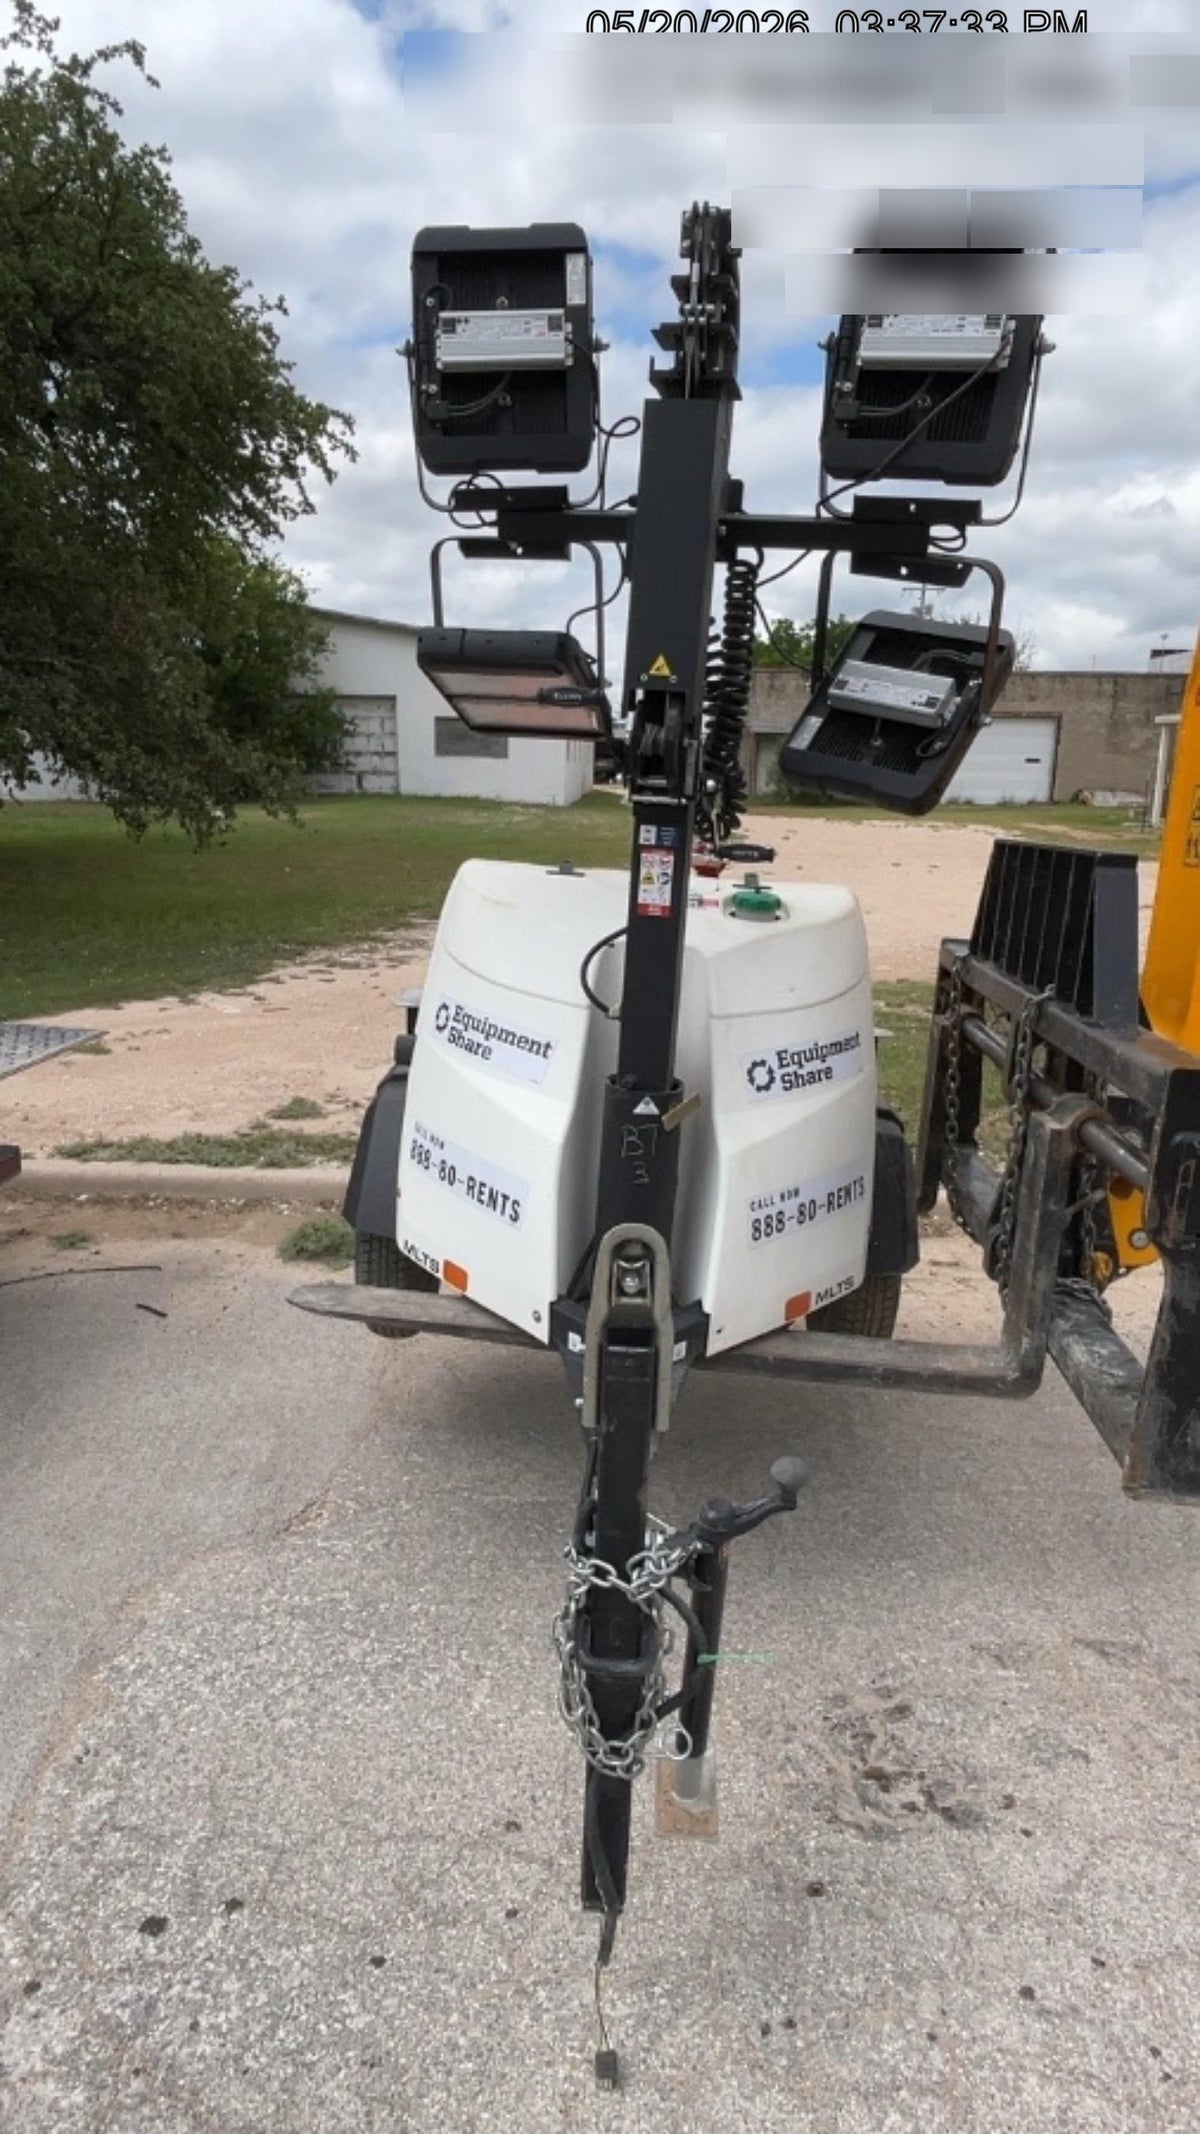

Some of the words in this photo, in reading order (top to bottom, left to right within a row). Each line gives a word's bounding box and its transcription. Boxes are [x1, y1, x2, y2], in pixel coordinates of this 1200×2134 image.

[448, 1026, 493, 1060] Share
[453, 1005, 552, 1059] Equipment
[776, 1031, 860, 1069] Equipment
[780, 1066, 833, 1091] Share
[750, 1195, 775, 1212] CALL
[751, 1176, 865, 1242] 888-80-RENTS
[815, 1275, 855, 1305] MLTS
